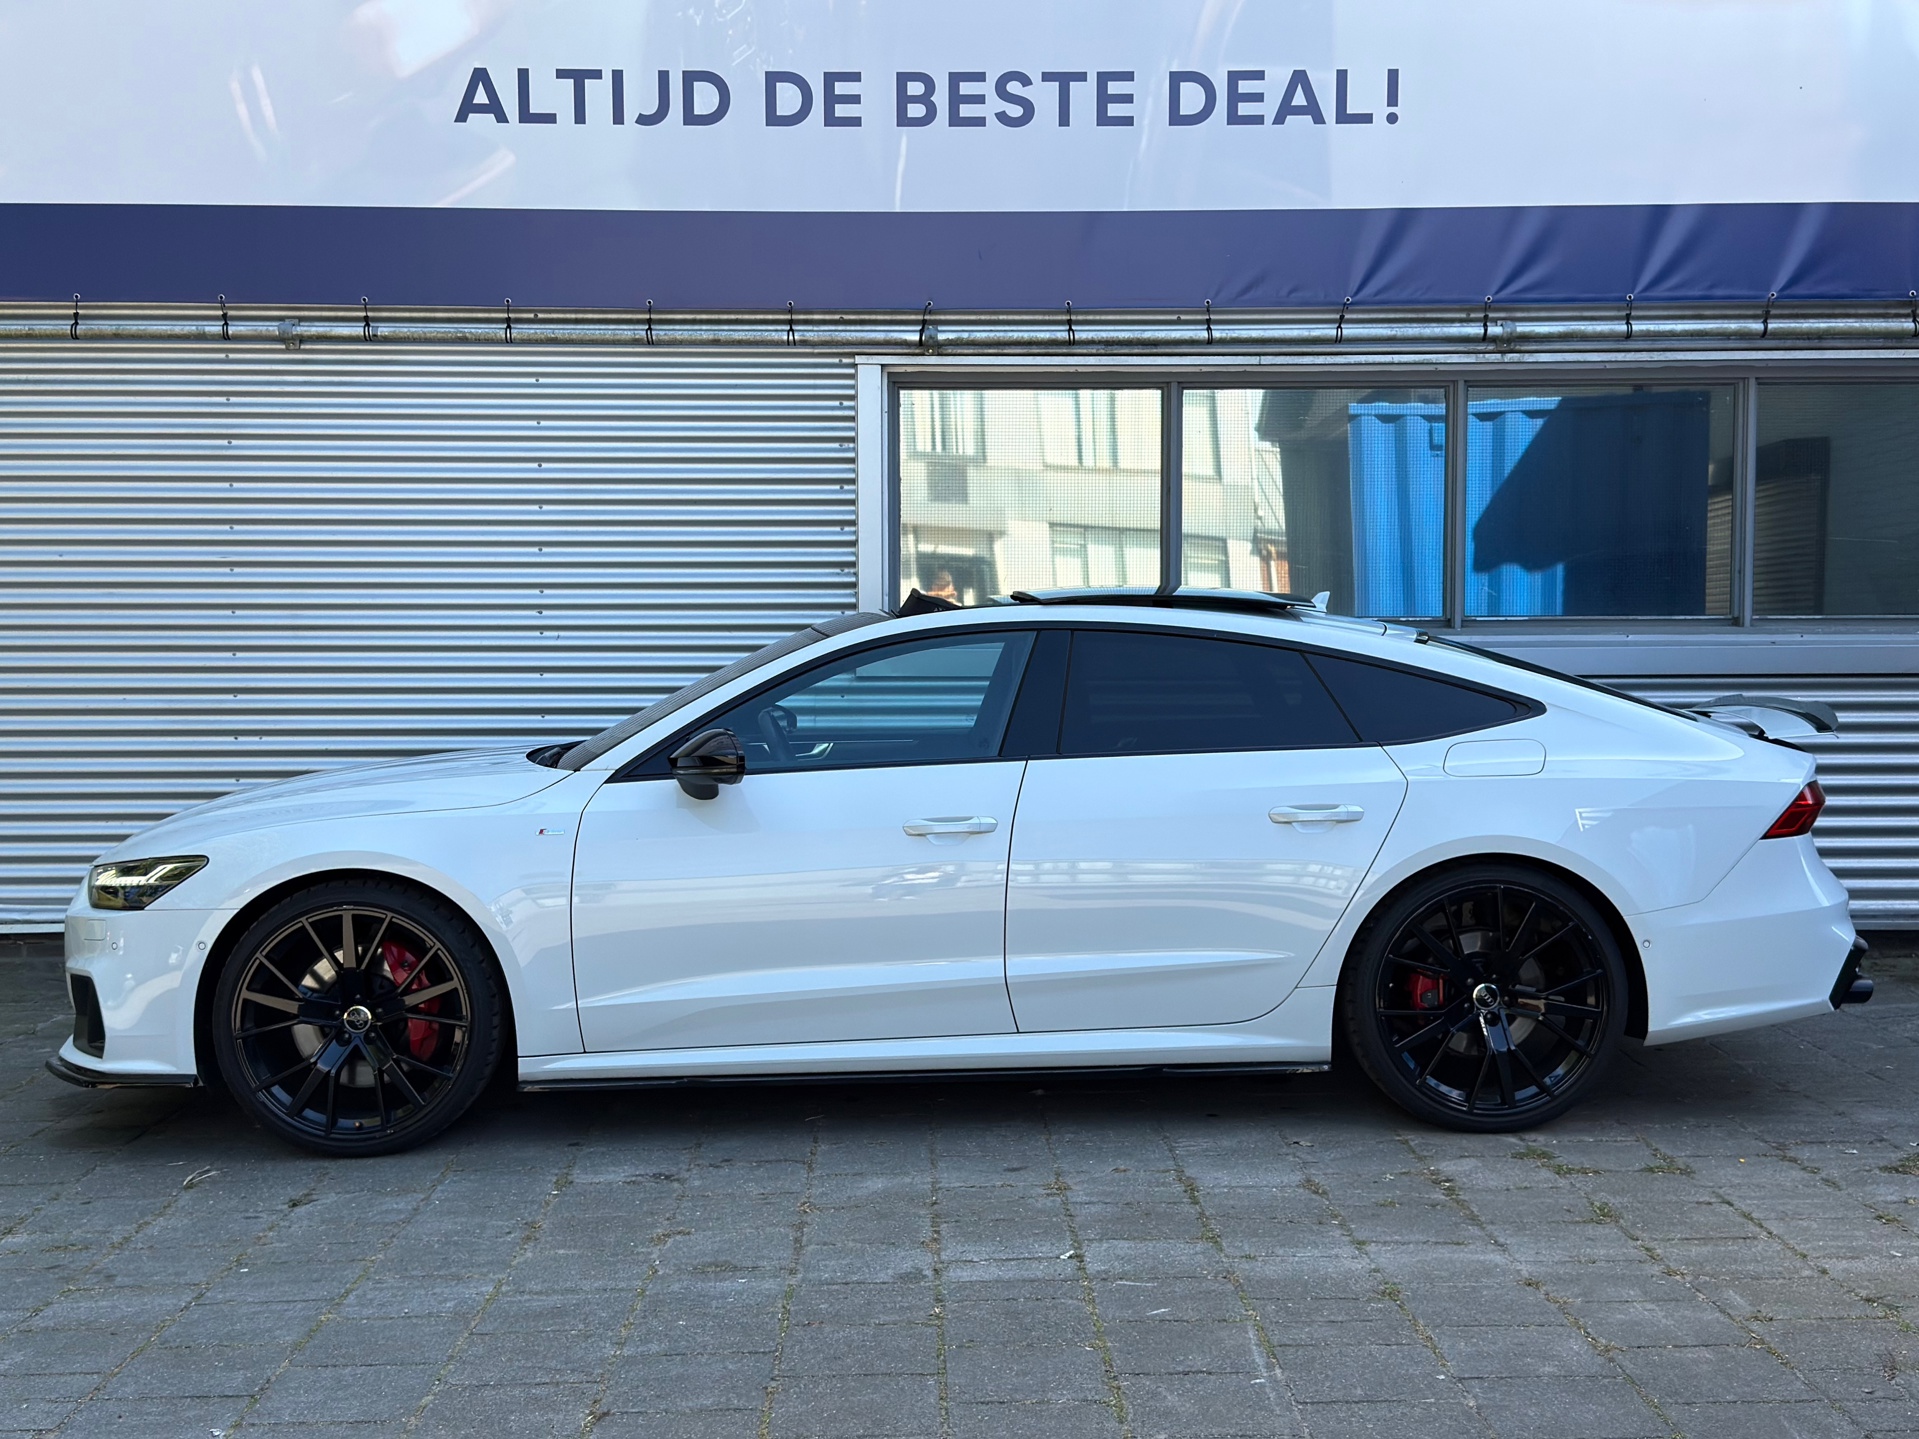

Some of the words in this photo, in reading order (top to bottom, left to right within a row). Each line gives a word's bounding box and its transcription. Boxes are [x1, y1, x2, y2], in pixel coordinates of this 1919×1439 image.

[454, 68, 731, 127] ALTIJD
[765, 71, 863, 127] DE
[896, 71, 1135, 127] BESTE
[1169, 69, 1400, 127] DEAL!
